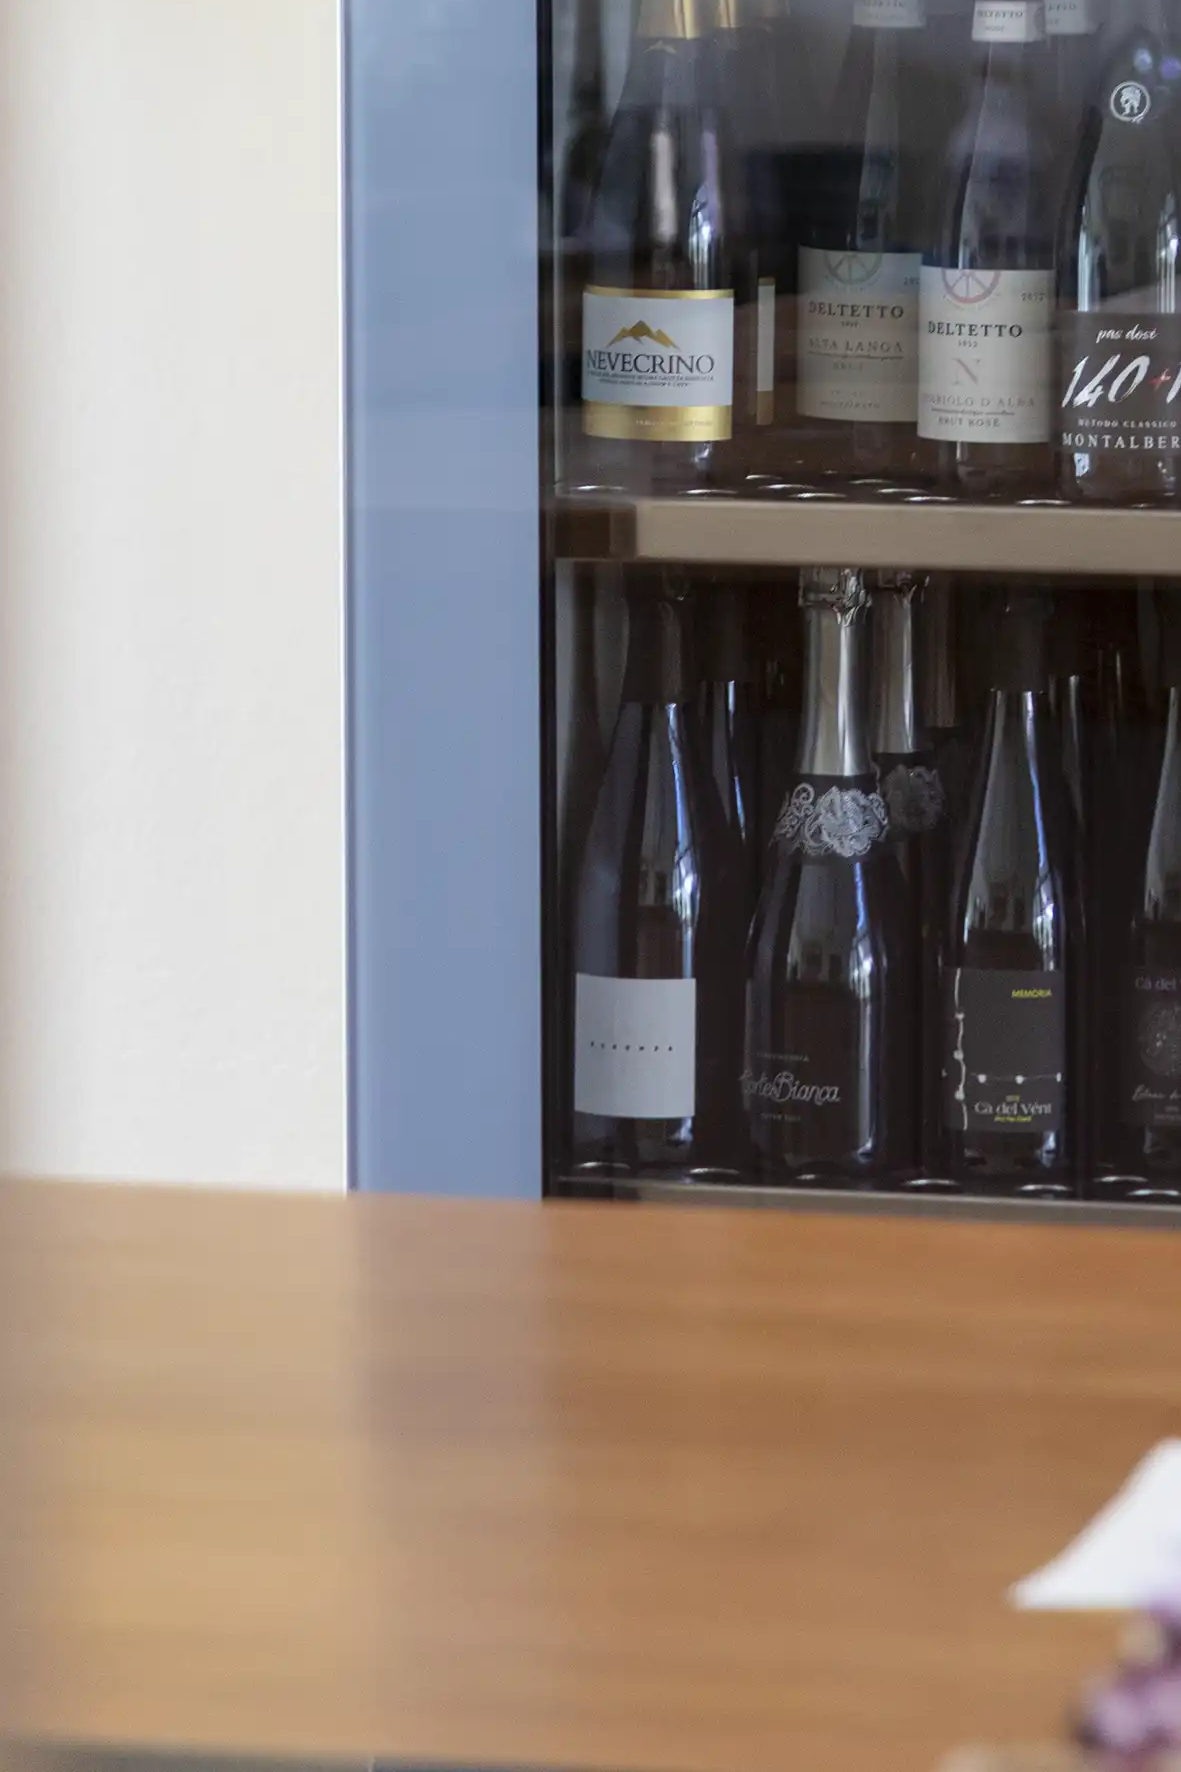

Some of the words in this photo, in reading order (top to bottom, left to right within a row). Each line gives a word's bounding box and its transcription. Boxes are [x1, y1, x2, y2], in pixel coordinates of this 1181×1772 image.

[808, 300, 904, 319] DELTETTO
[928, 320, 1023, 338] DELTETTO
[586, 349, 715, 375] NEVECRINO
